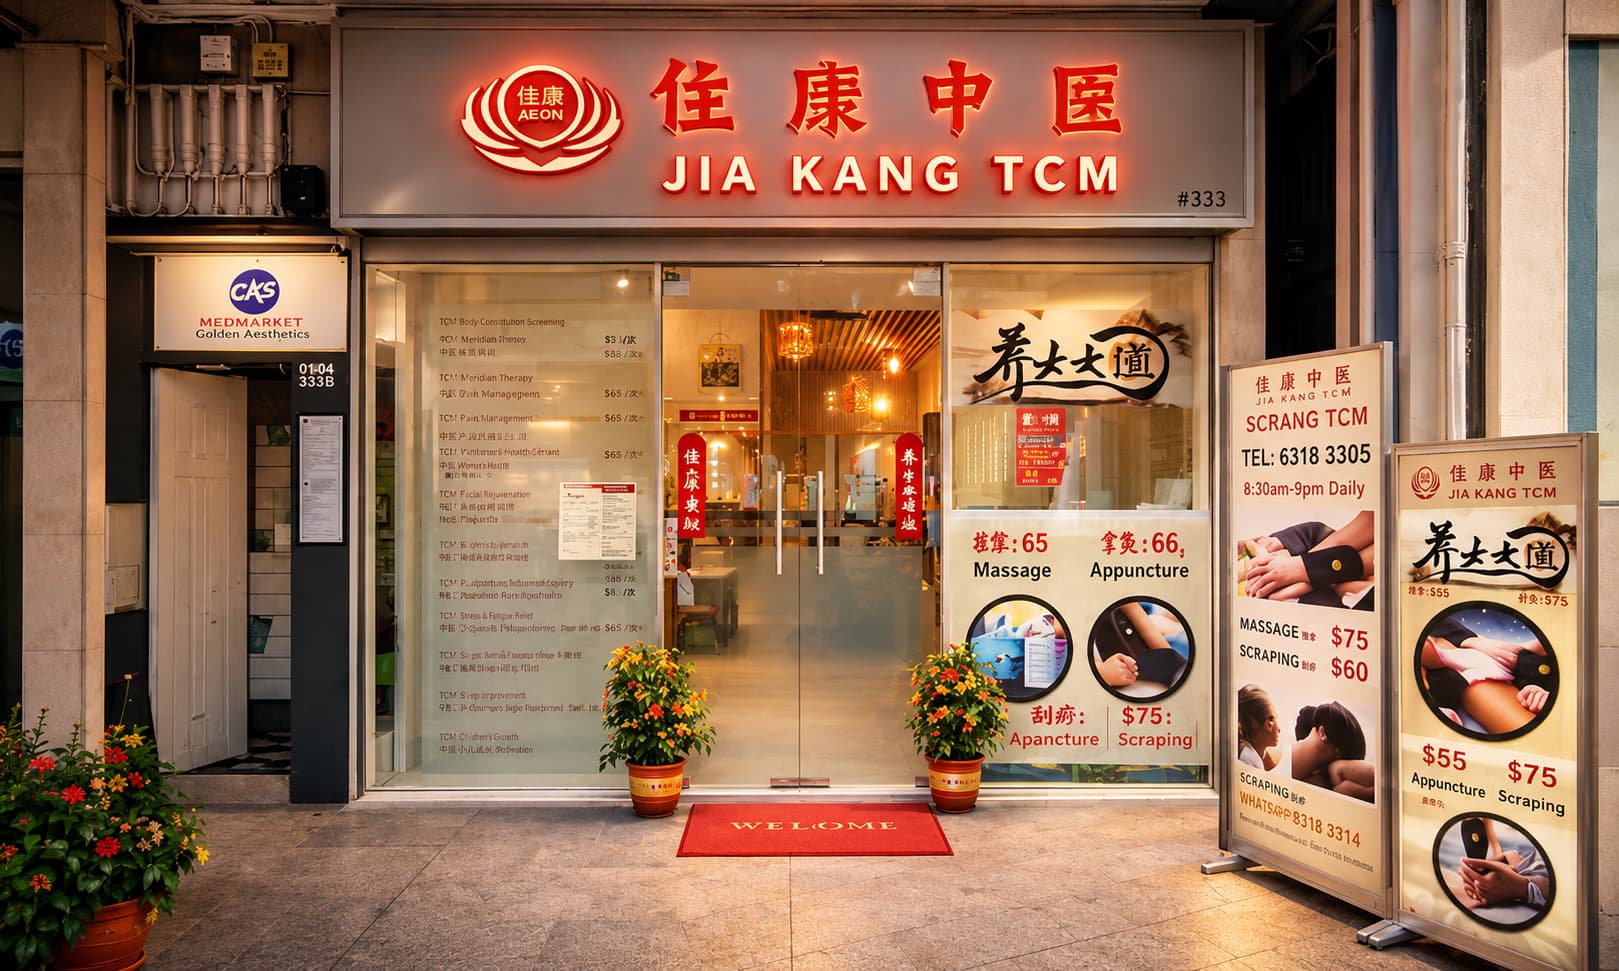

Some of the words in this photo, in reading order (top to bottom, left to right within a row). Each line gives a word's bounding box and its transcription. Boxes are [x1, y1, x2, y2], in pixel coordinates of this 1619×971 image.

[517, 85, 564, 106] 佳康
[518, 109, 563, 121] AEON
[662, 155, 756, 192] JIA
[792, 155, 959, 192] KANG
[993, 155, 1118, 192] TCM
[1177, 190, 1227, 207] #333
[199, 317, 304, 327] MEDMARKET
[195, 329, 240, 339] Golden
[243, 329, 310, 339] Aesthetics
[299, 363, 334, 375] 01-04
[500, 373, 533, 384] Therapy
[299, 376, 335, 387] 333B
[1255, 365, 1351, 394] 佳康中医
[1256, 397, 1274, 406] JIA
[1281, 391, 1315, 403] KANG
[1323, 387, 1351, 398] TCM
[1246, 410, 1318, 433] SCRANG
[1325, 406, 1368, 427] TCM
[1241, 448, 1274, 467] TEL:
[1280, 446, 1319, 466] 6318
[1325, 443, 1371, 465] 3305
[1450, 460, 1556, 483] 佳康中医
[1243, 481, 1324, 499] 8:30am-9pm
[1329, 480, 1365, 500] Daily
[1448, 489, 1470, 500] JIA
[1475, 488, 1517, 499] KANG
[1522, 487, 1557, 498] TCM
[974, 561, 1052, 581] Massage
[1090, 562, 1189, 581] Appuncture
[1240, 617, 1299, 639] MASSAGE
[1331, 625, 1368, 650] $75
[1239, 644, 1299, 668] SCRAPING
[1331, 656, 1368, 682] $60
[1009, 732, 1099, 749] Apancture
[1118, 732, 1193, 750] Scraping
[1422, 743, 1467, 771] $55
[1508, 759, 1557, 788] $75
[1240, 772, 1289, 799] SCRAPING
[1411, 772, 1486, 798] Appuncture
[1498, 790, 1566, 817] Scraping
[1293, 811, 1322, 834] 8318
[1327, 823, 1361, 848] 3314
